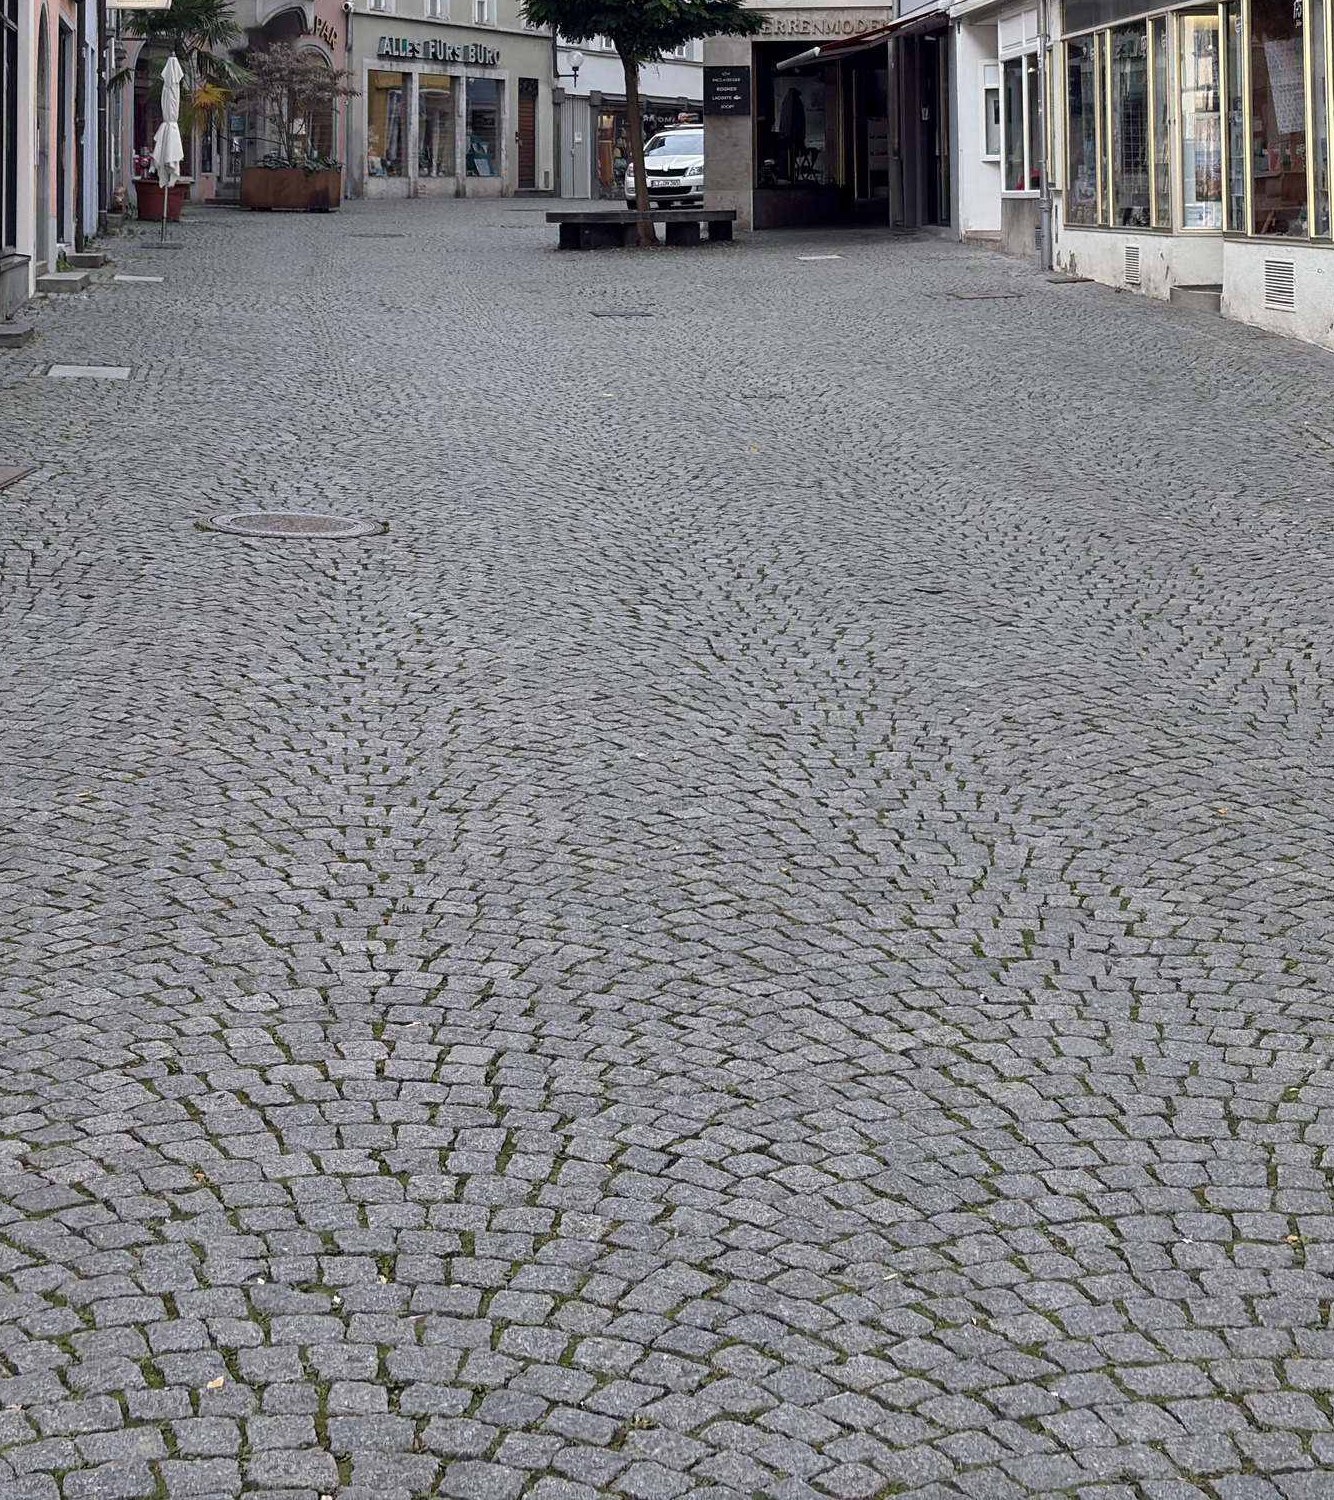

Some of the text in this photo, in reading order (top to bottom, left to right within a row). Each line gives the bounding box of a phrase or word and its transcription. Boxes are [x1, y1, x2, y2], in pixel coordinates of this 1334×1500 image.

[378, 37, 502, 65] ALLES FÜRS BÜRO
